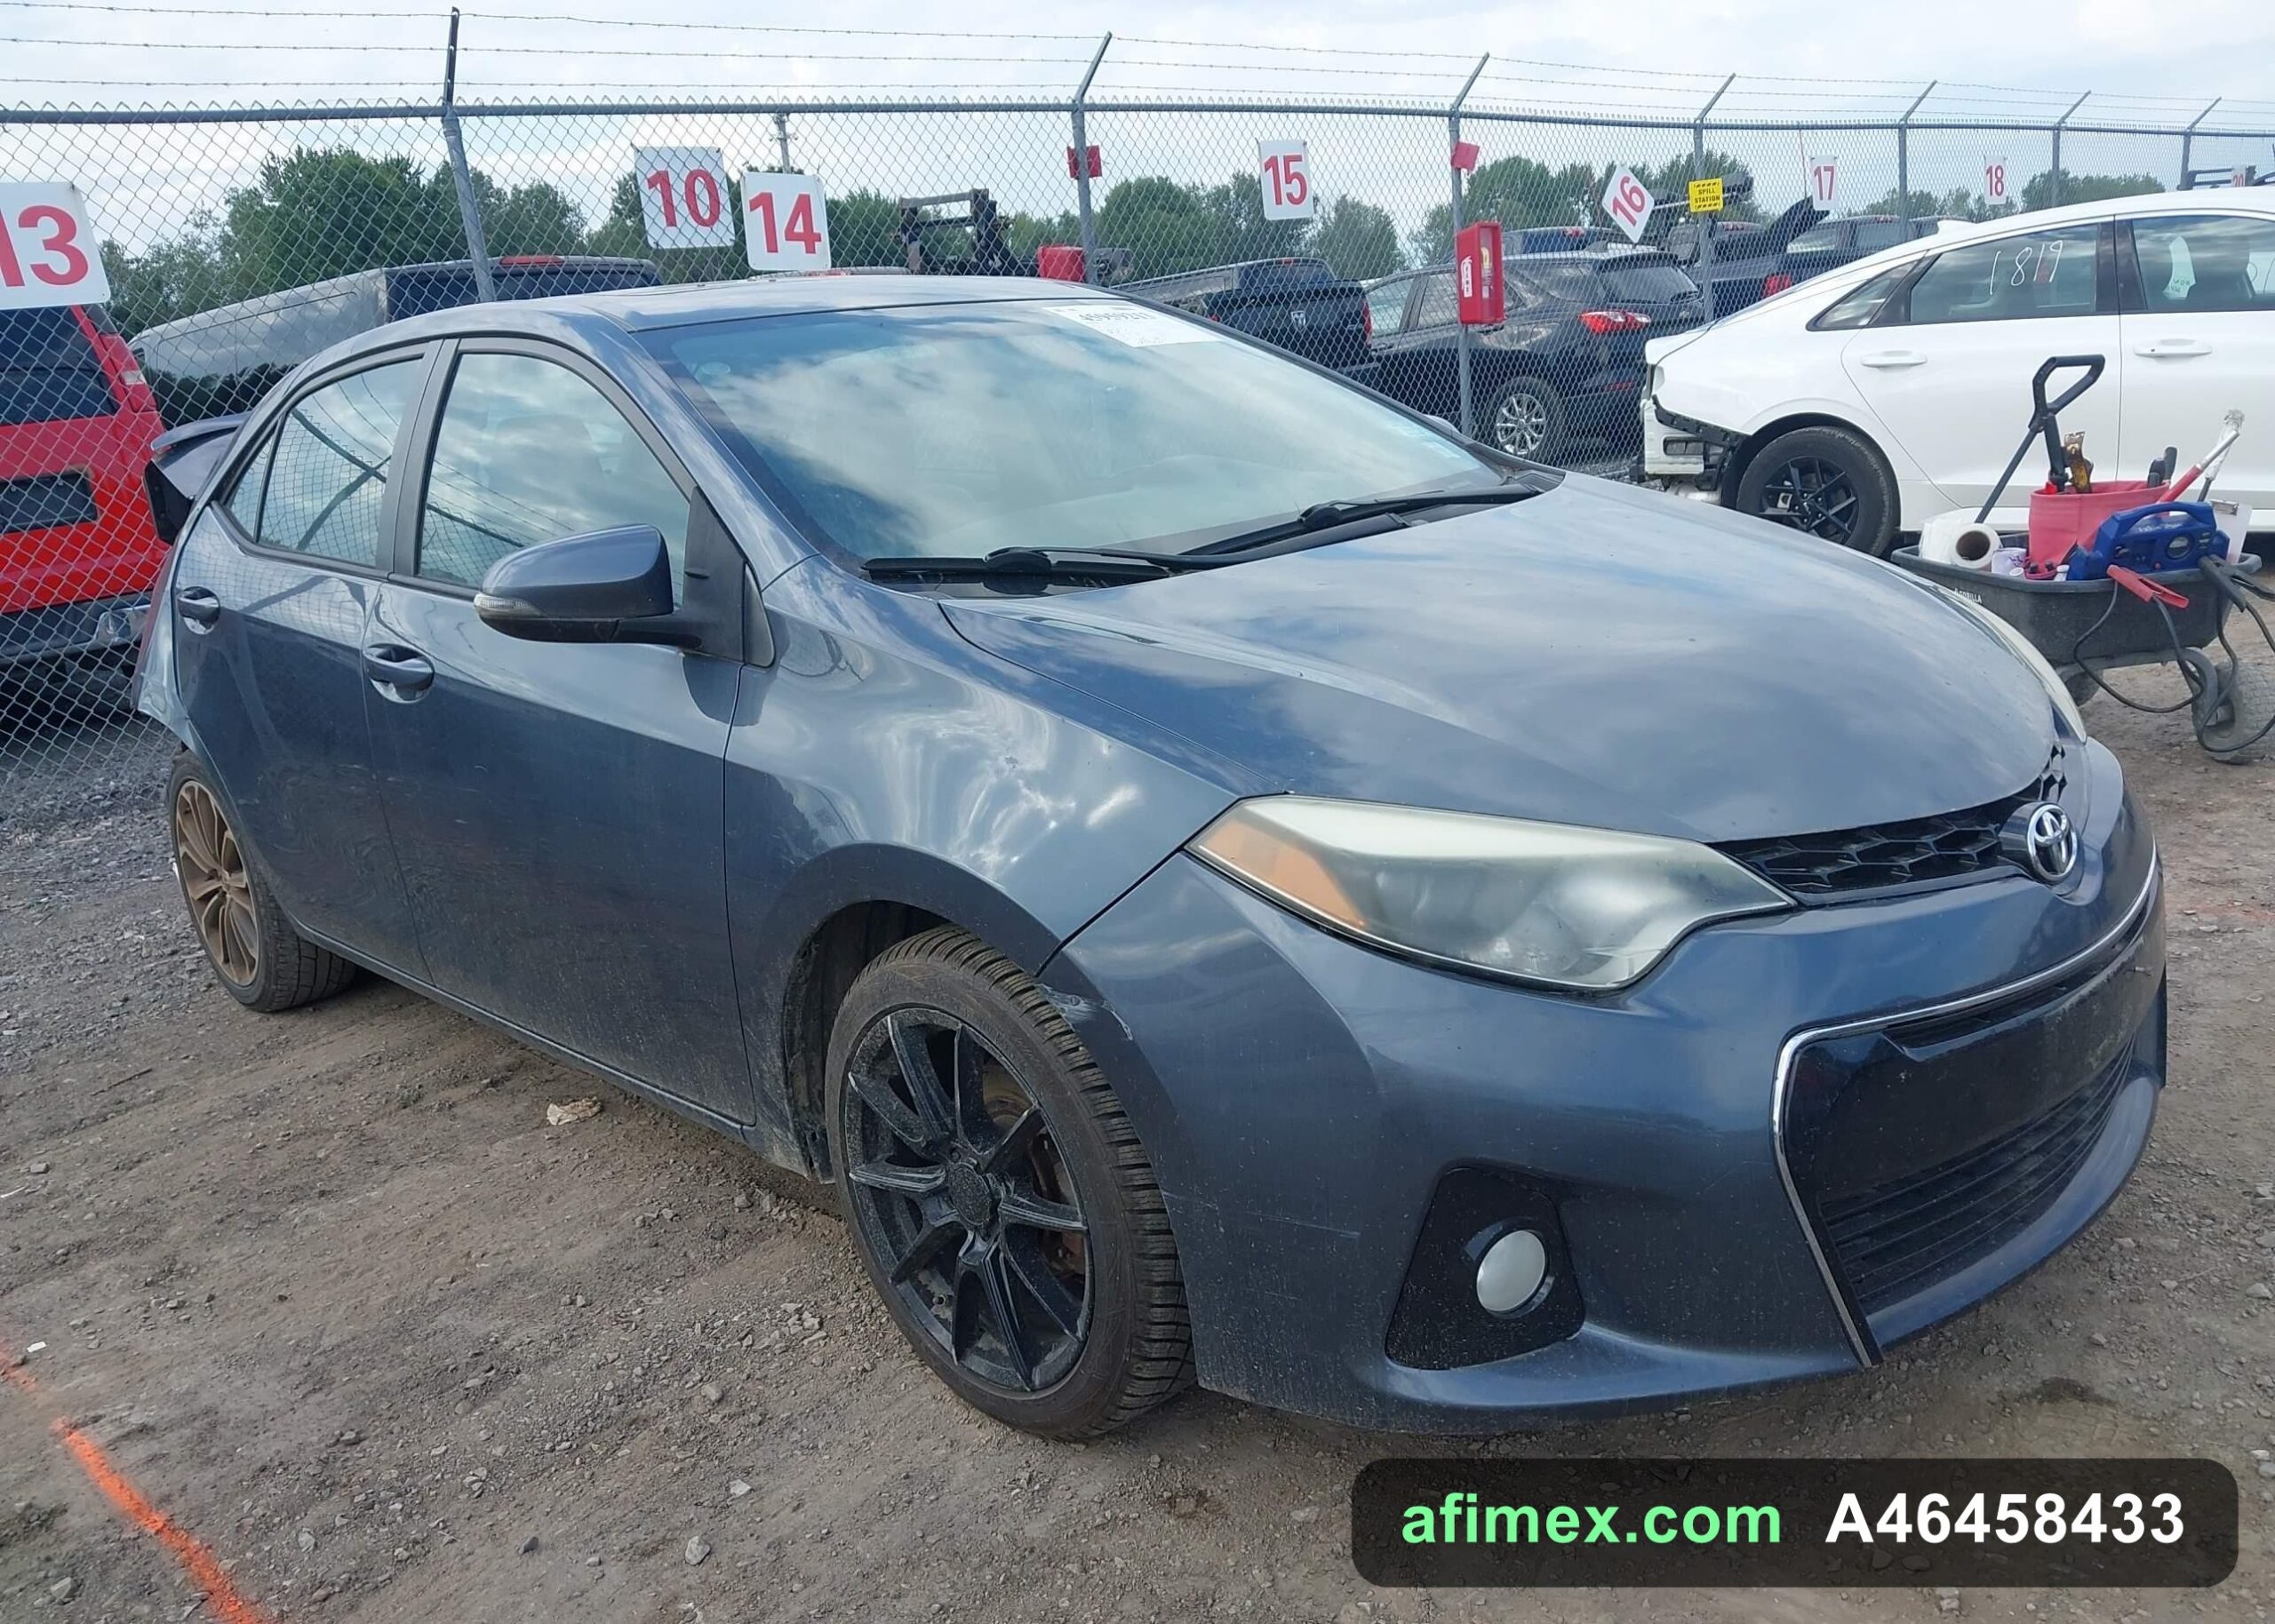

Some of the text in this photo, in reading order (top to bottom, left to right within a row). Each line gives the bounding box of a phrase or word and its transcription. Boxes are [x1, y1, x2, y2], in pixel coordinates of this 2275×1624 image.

[647, 168, 721, 227] 10
[1264, 155, 1308, 205] 15
[1612, 175, 1646, 227] 16
[1694, 195, 1720, 203] STATION
[1814, 165, 1834, 201] 17
[1985, 164, 2005, 196] 18
[748, 191, 822, 254] 14
[1990, 240, 2063, 295] 1819
